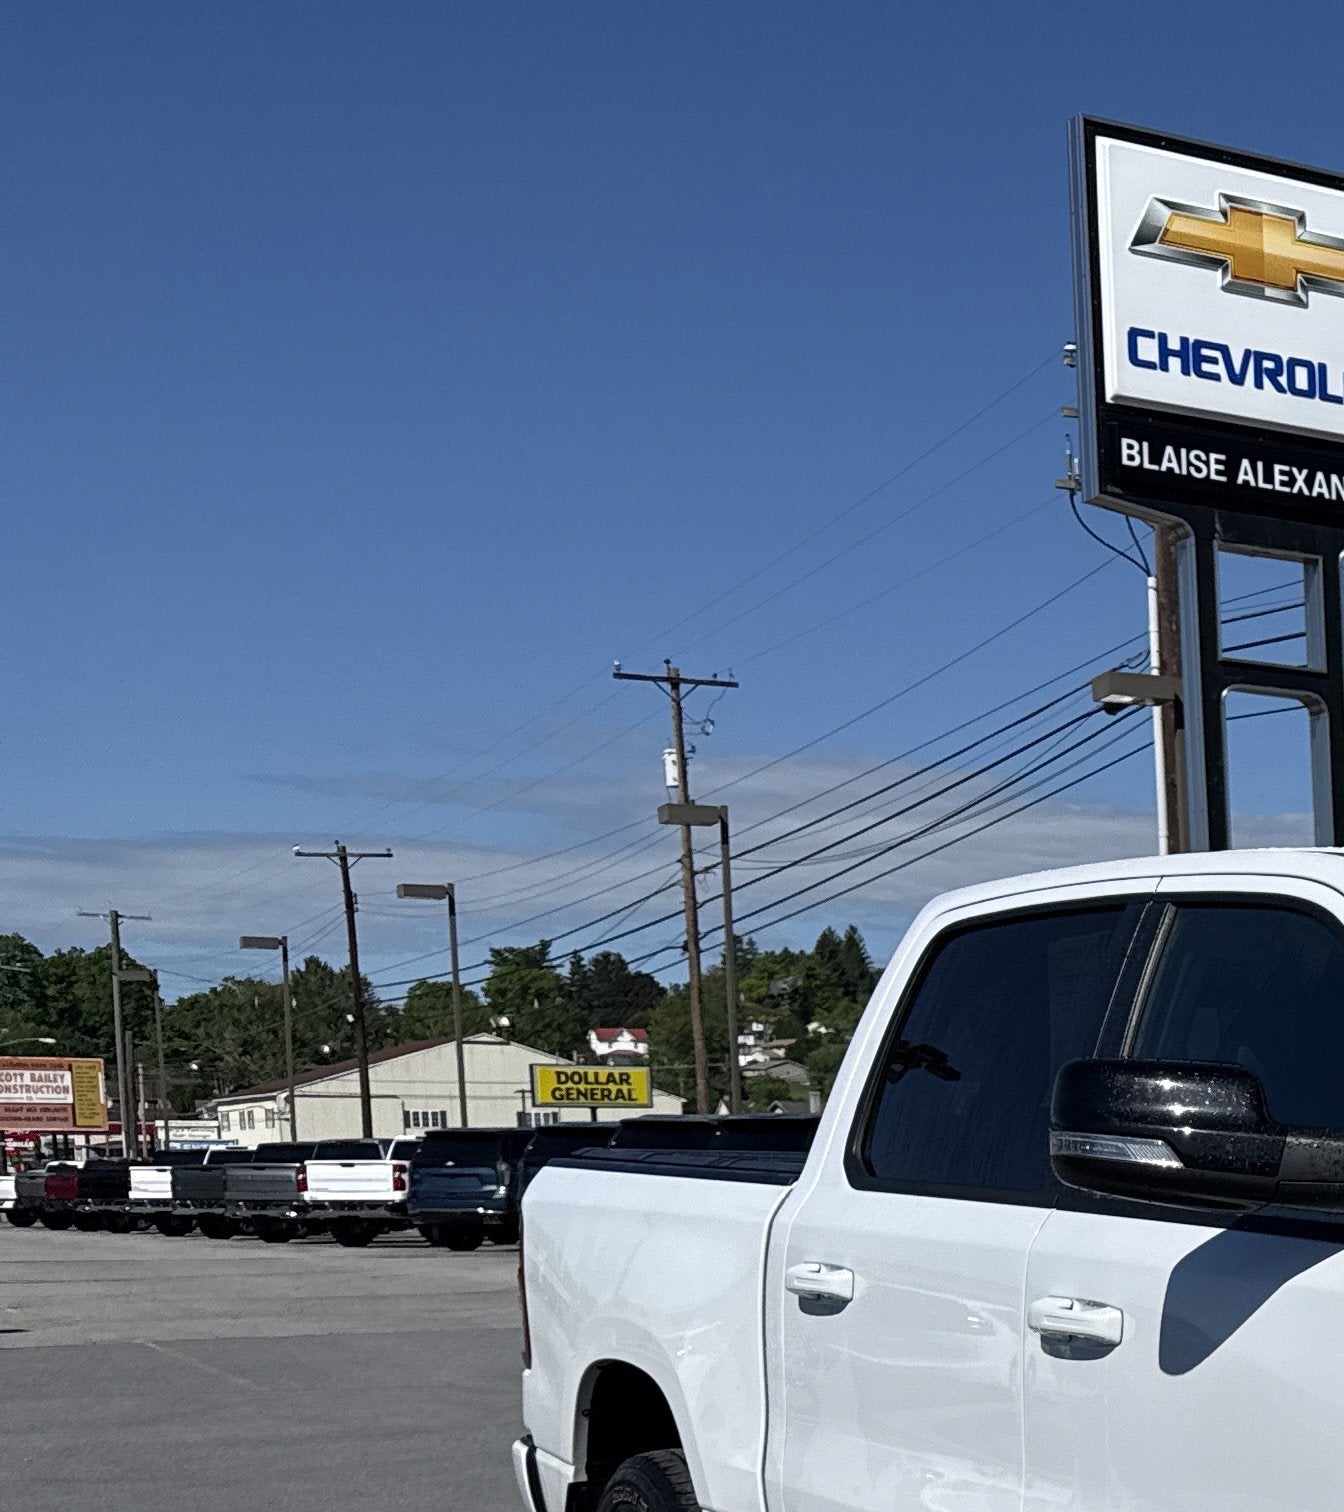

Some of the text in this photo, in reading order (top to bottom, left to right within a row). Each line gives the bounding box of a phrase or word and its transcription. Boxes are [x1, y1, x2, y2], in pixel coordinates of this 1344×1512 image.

[1121, 437, 1227, 482] BLAISE
[30, 1073, 65, 1084] BAILEY
[554, 1070, 632, 1086] DOLLAR
[550, 1086, 638, 1102] GENERAL
